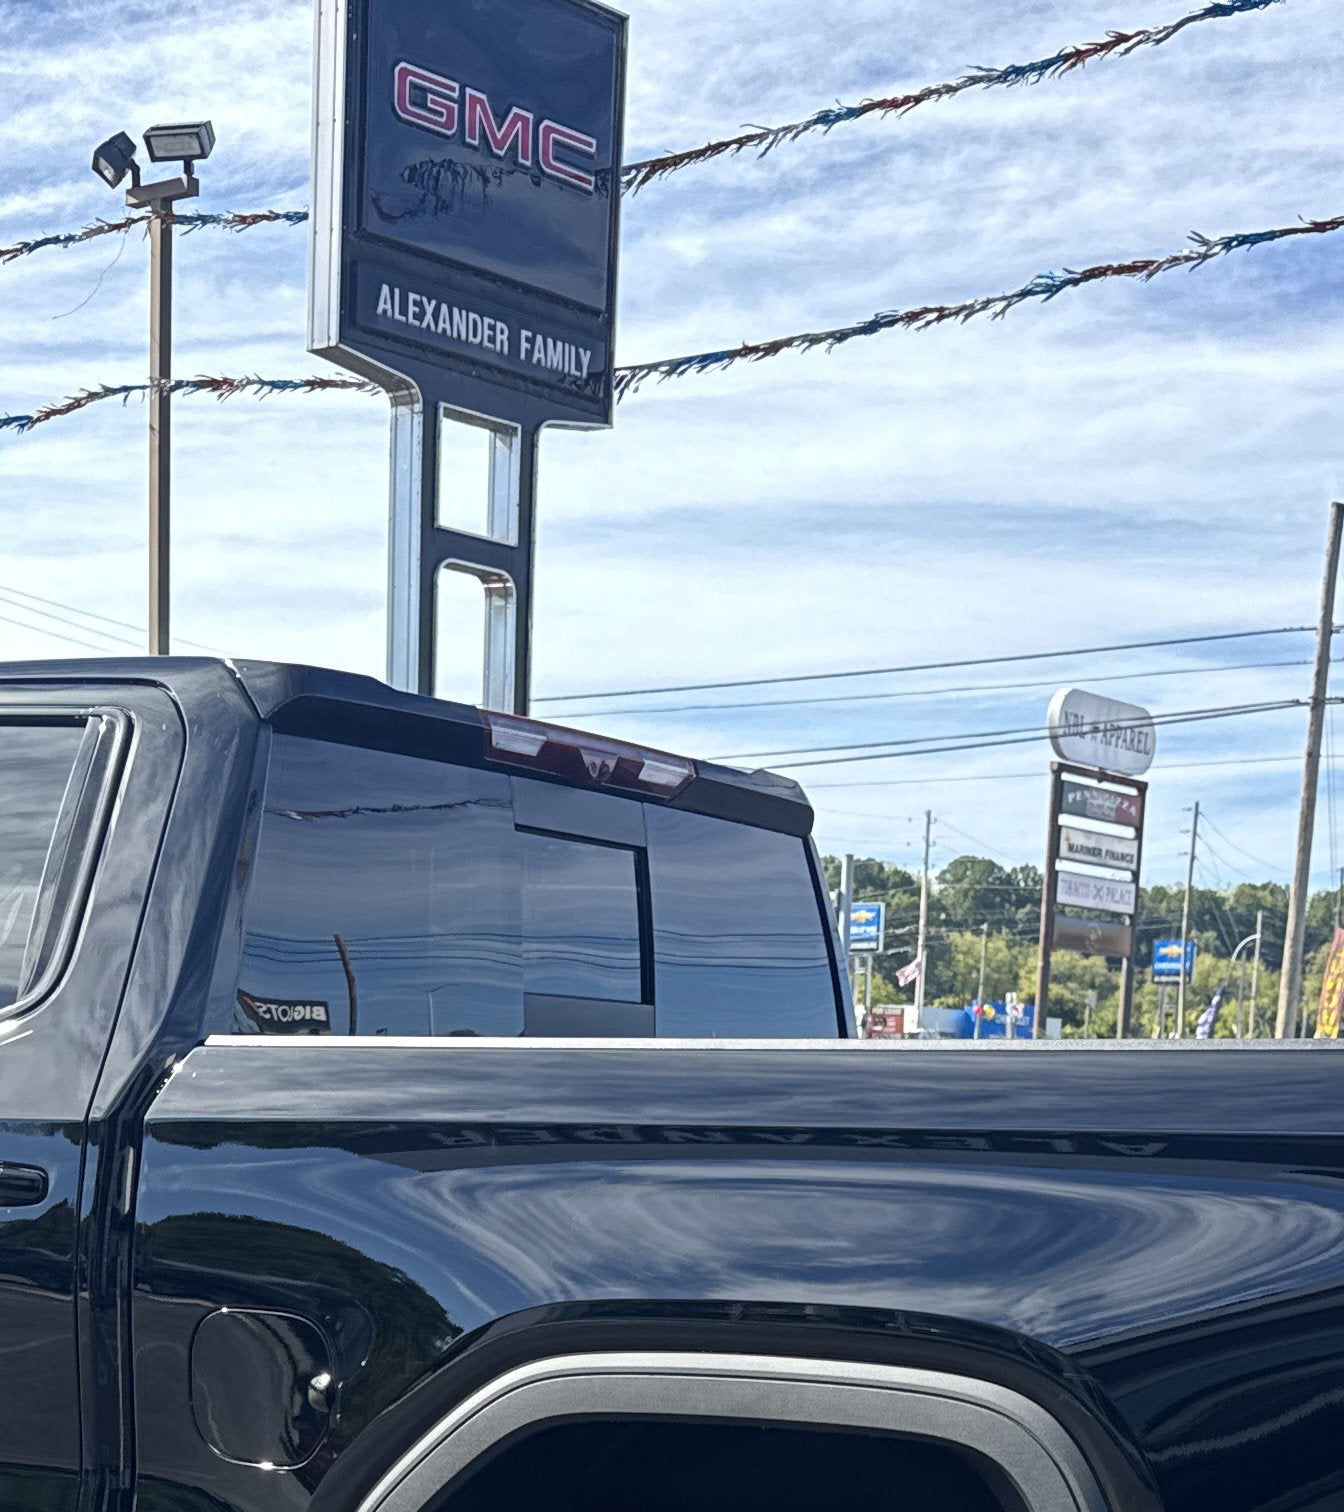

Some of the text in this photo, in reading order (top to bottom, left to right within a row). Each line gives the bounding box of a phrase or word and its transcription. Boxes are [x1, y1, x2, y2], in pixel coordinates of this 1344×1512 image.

[394, 61, 597, 194] GMC
[376, 284, 592, 379] ALEXANDER FAMILY
